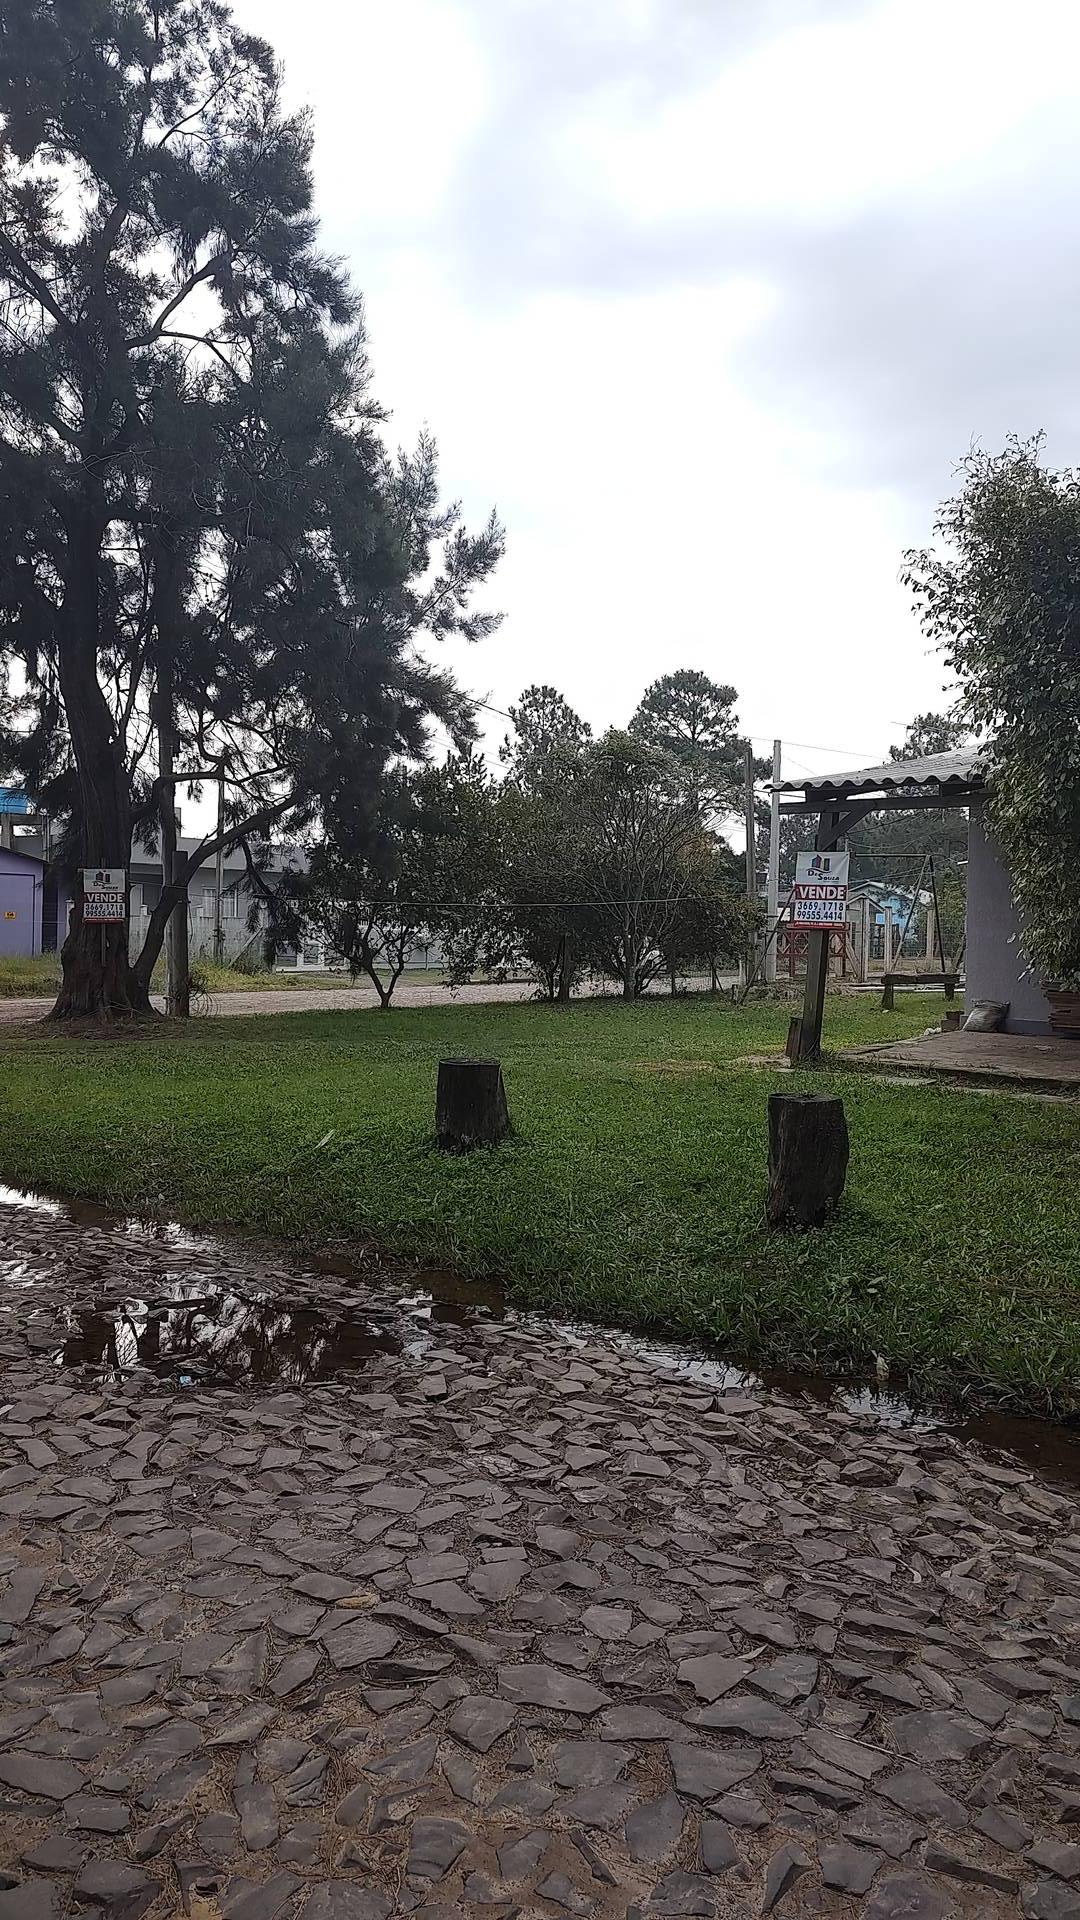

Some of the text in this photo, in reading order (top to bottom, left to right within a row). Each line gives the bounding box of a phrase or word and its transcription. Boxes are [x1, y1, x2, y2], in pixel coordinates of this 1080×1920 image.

[799, 886, 844, 899] VENDE
[87, 893, 123, 902] VENDE
[798, 901, 844, 911] 3669.1718
[797, 911, 843, 920] 99555.4414
